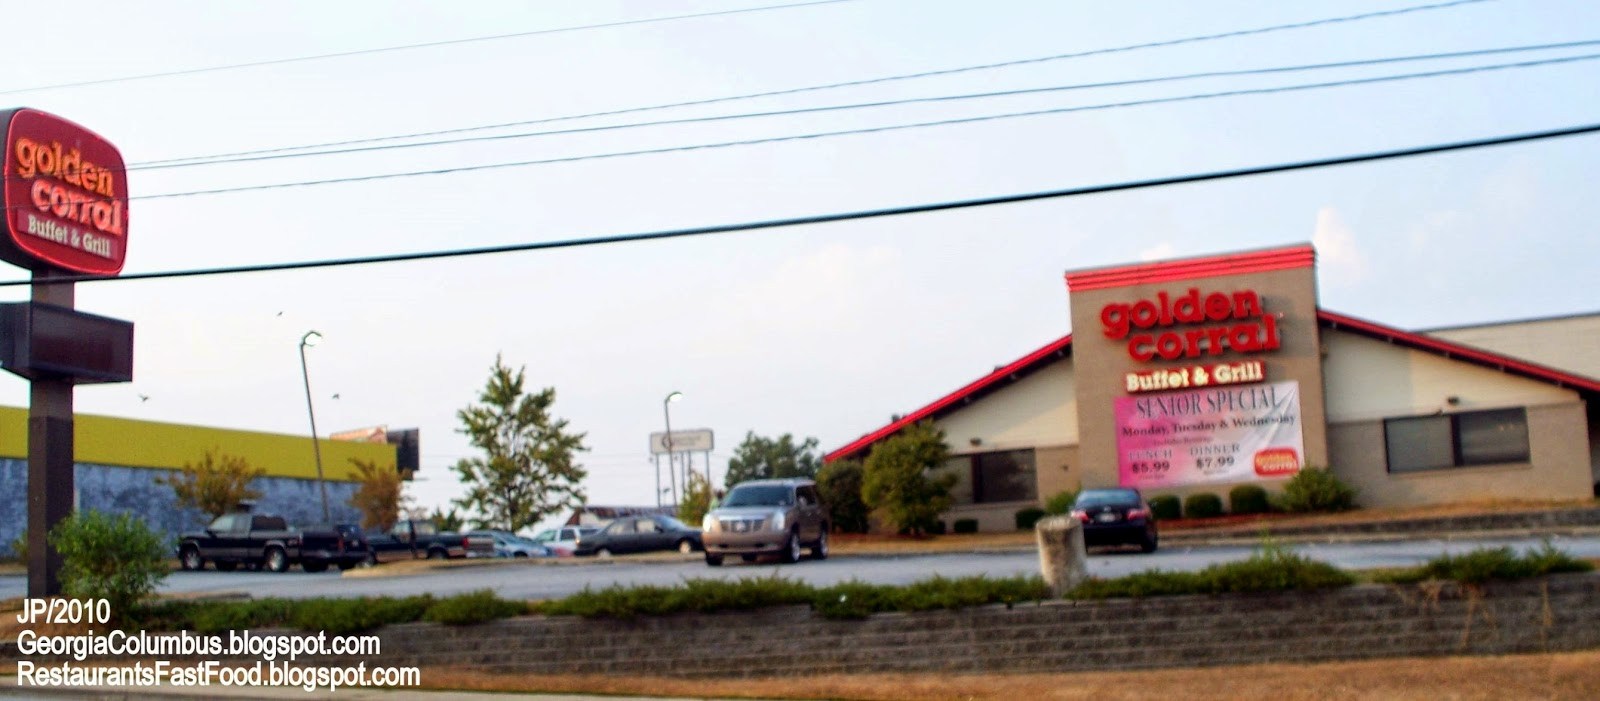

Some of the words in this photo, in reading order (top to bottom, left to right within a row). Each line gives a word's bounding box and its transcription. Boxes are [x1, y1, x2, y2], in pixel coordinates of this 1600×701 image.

[16, 138, 114, 197] golden
[32, 179, 122, 235] corral
[28, 214, 68, 244] Buffet
[71, 231, 80, 247] &
[83, 233, 111, 257] Grill
[1100, 288, 1263, 340] golden
[1128, 313, 1280, 362] corral
[1126, 367, 1189, 392] Buffet
[1193, 369, 1209, 386] &
[1213, 361, 1263, 383] Grill
[1136, 393, 1202, 418] SENIOR
[1207, 386, 1278, 413] SPECIAL
[1122, 423, 1171, 437] Monday,
[1173, 419, 1217, 433] Tuesday
[1220, 419, 1229, 428] &
[1232, 414, 1296, 428] Wednesday
[1129, 449, 1172, 461] LUNCH
[1190, 443, 1240, 456] DINNER
[1196, 456, 1235, 469] $7.99
[1132, 460, 1170, 473] $5.99
